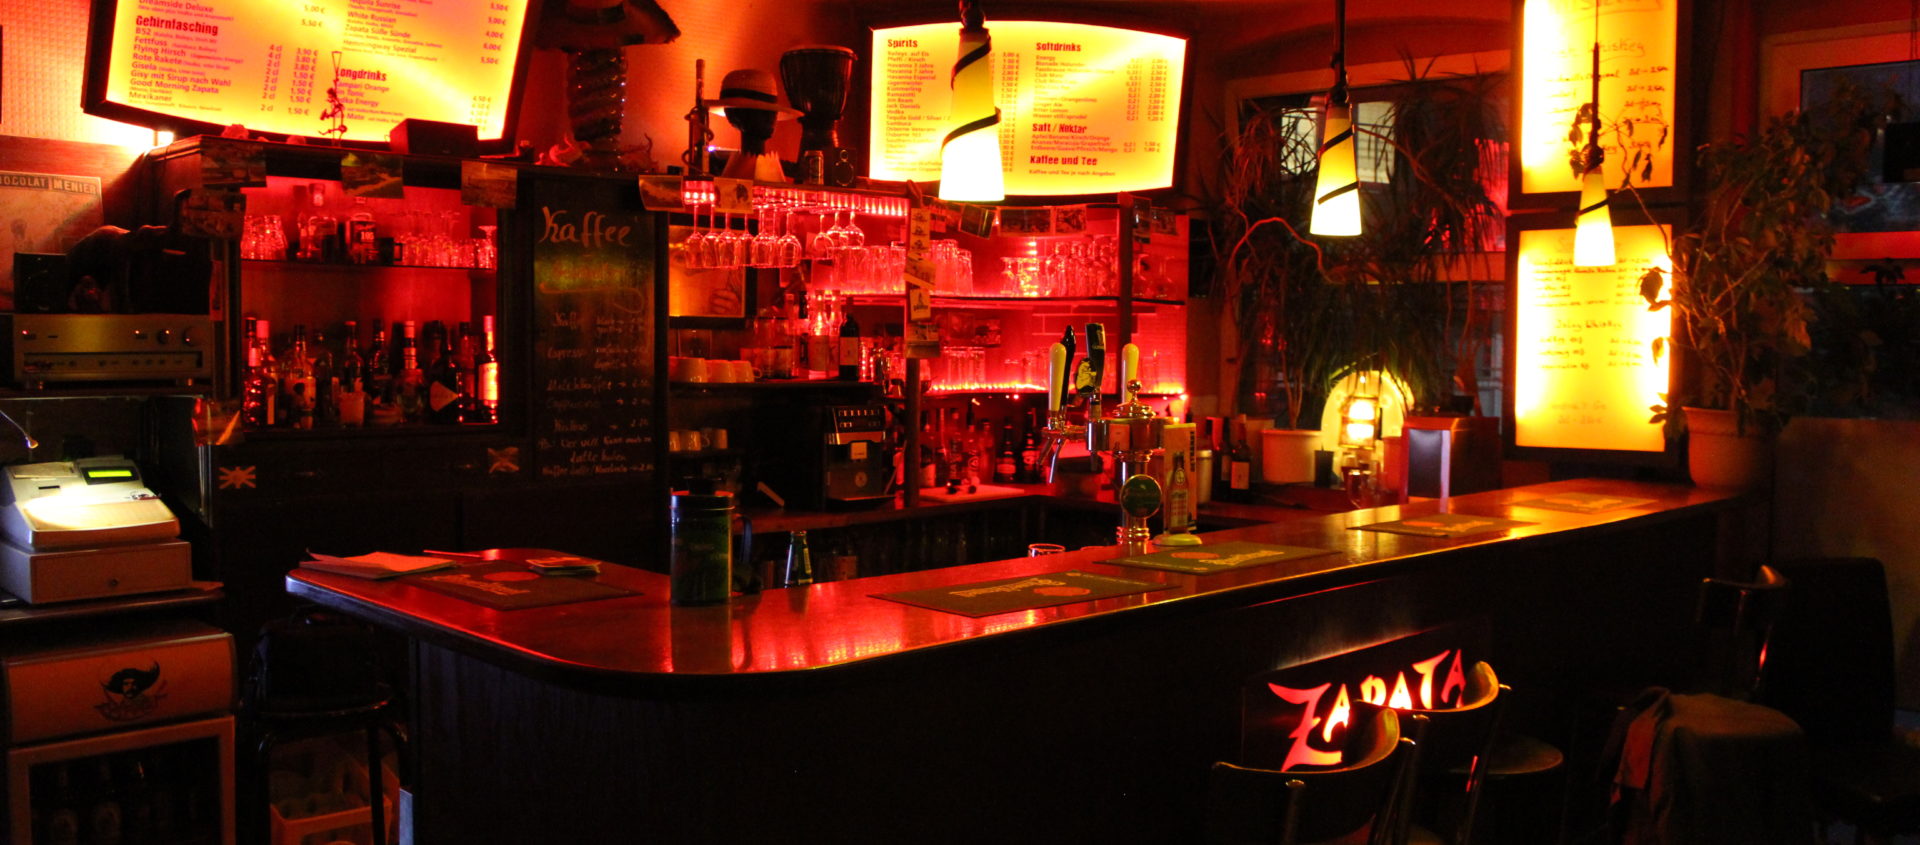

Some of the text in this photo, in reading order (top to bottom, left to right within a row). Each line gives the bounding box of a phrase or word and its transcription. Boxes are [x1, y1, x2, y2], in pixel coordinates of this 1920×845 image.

[136, 15, 219, 36] Gehirnfasching
[888, 39, 918, 48] Spirits
[1036, 41, 1082, 52] Softdrinks
[133, 44, 159, 55] Flying
[161, 47, 187, 57] Hirsch
[132, 52, 152, 62] Rote
[129, 78, 153, 87] Good
[154, 80, 190, 92] Morning
[191, 84, 219, 94] Zapata
[189, 76, 209, 84] nach
[210, 78, 232, 87] Wahl
[1032, 123, 1051, 132] Saft
[1029, 155, 1098, 166] Kaffee und Tee
[53, 177, 98, 195] MENIER
[539, 206, 632, 248] Kaffee
[1267, 648, 1467, 773] ZAPATA
